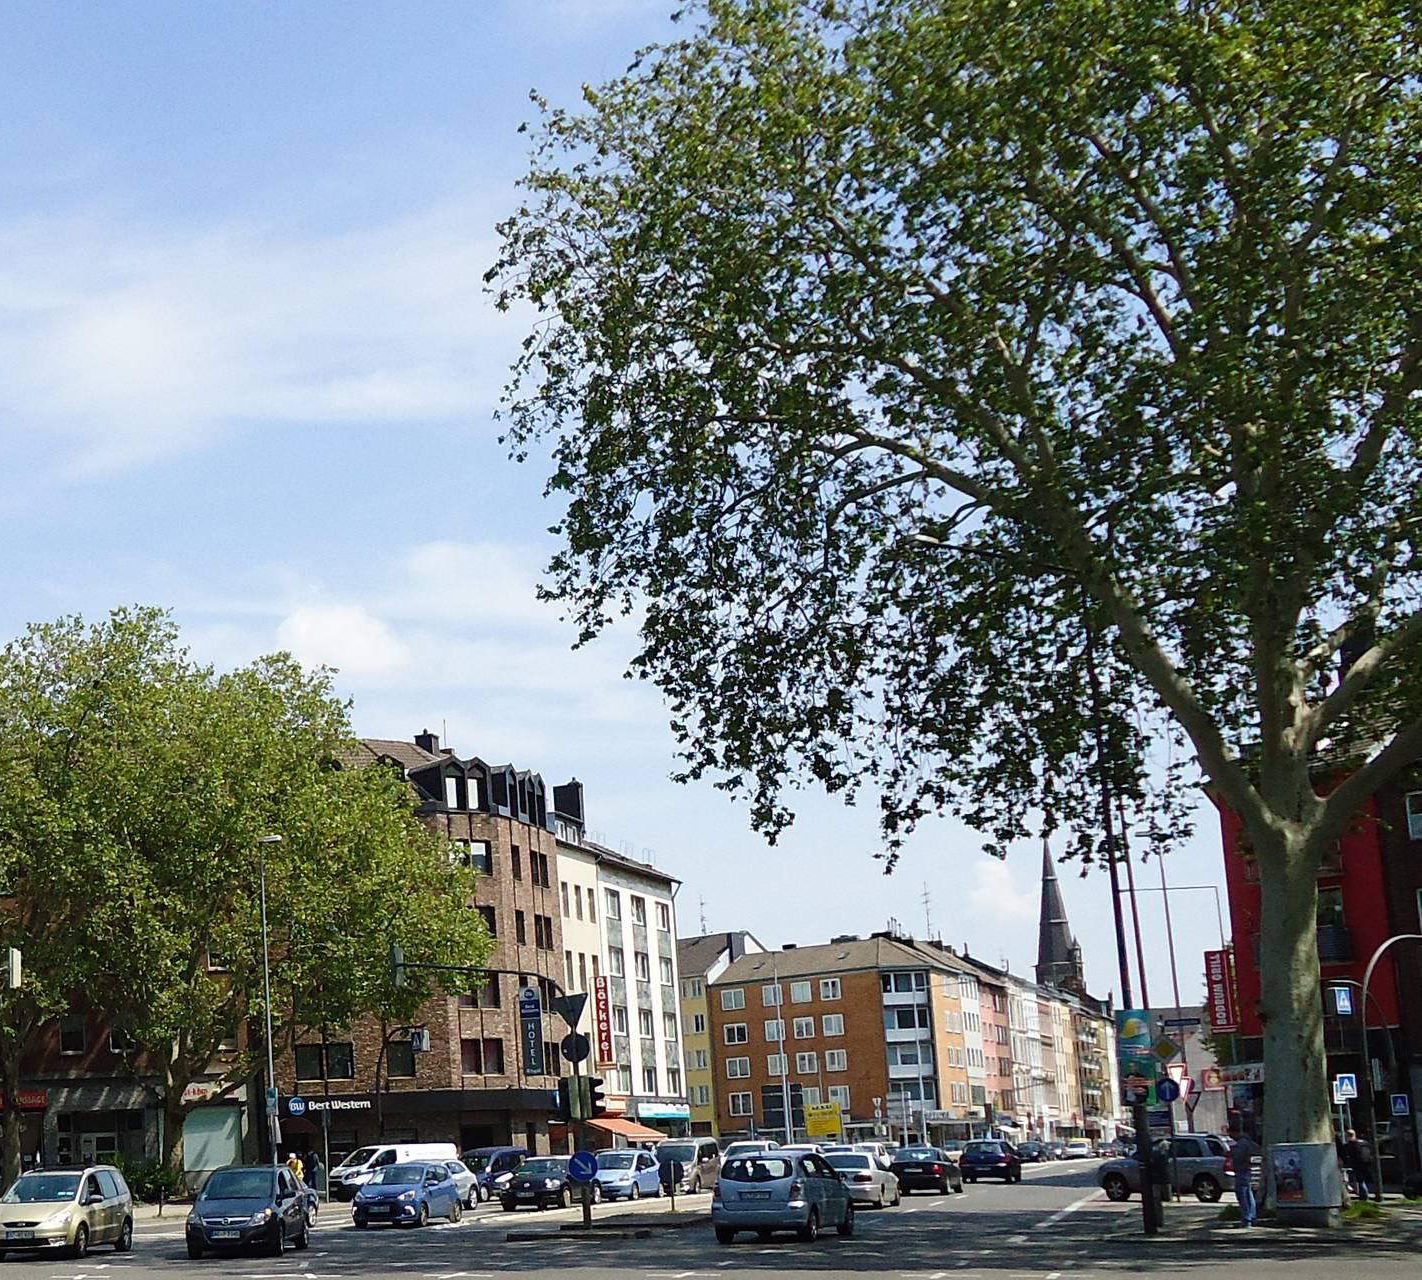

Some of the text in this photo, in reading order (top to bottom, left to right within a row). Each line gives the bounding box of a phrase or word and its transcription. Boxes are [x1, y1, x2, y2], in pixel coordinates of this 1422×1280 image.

[1209, 953, 1228, 1025] BODRUM GRILL
[527, 1022, 537, 1066] HOTEL
[596, 977, 610, 1062] Bäckerei
[331, 1100, 372, 1109] Western
